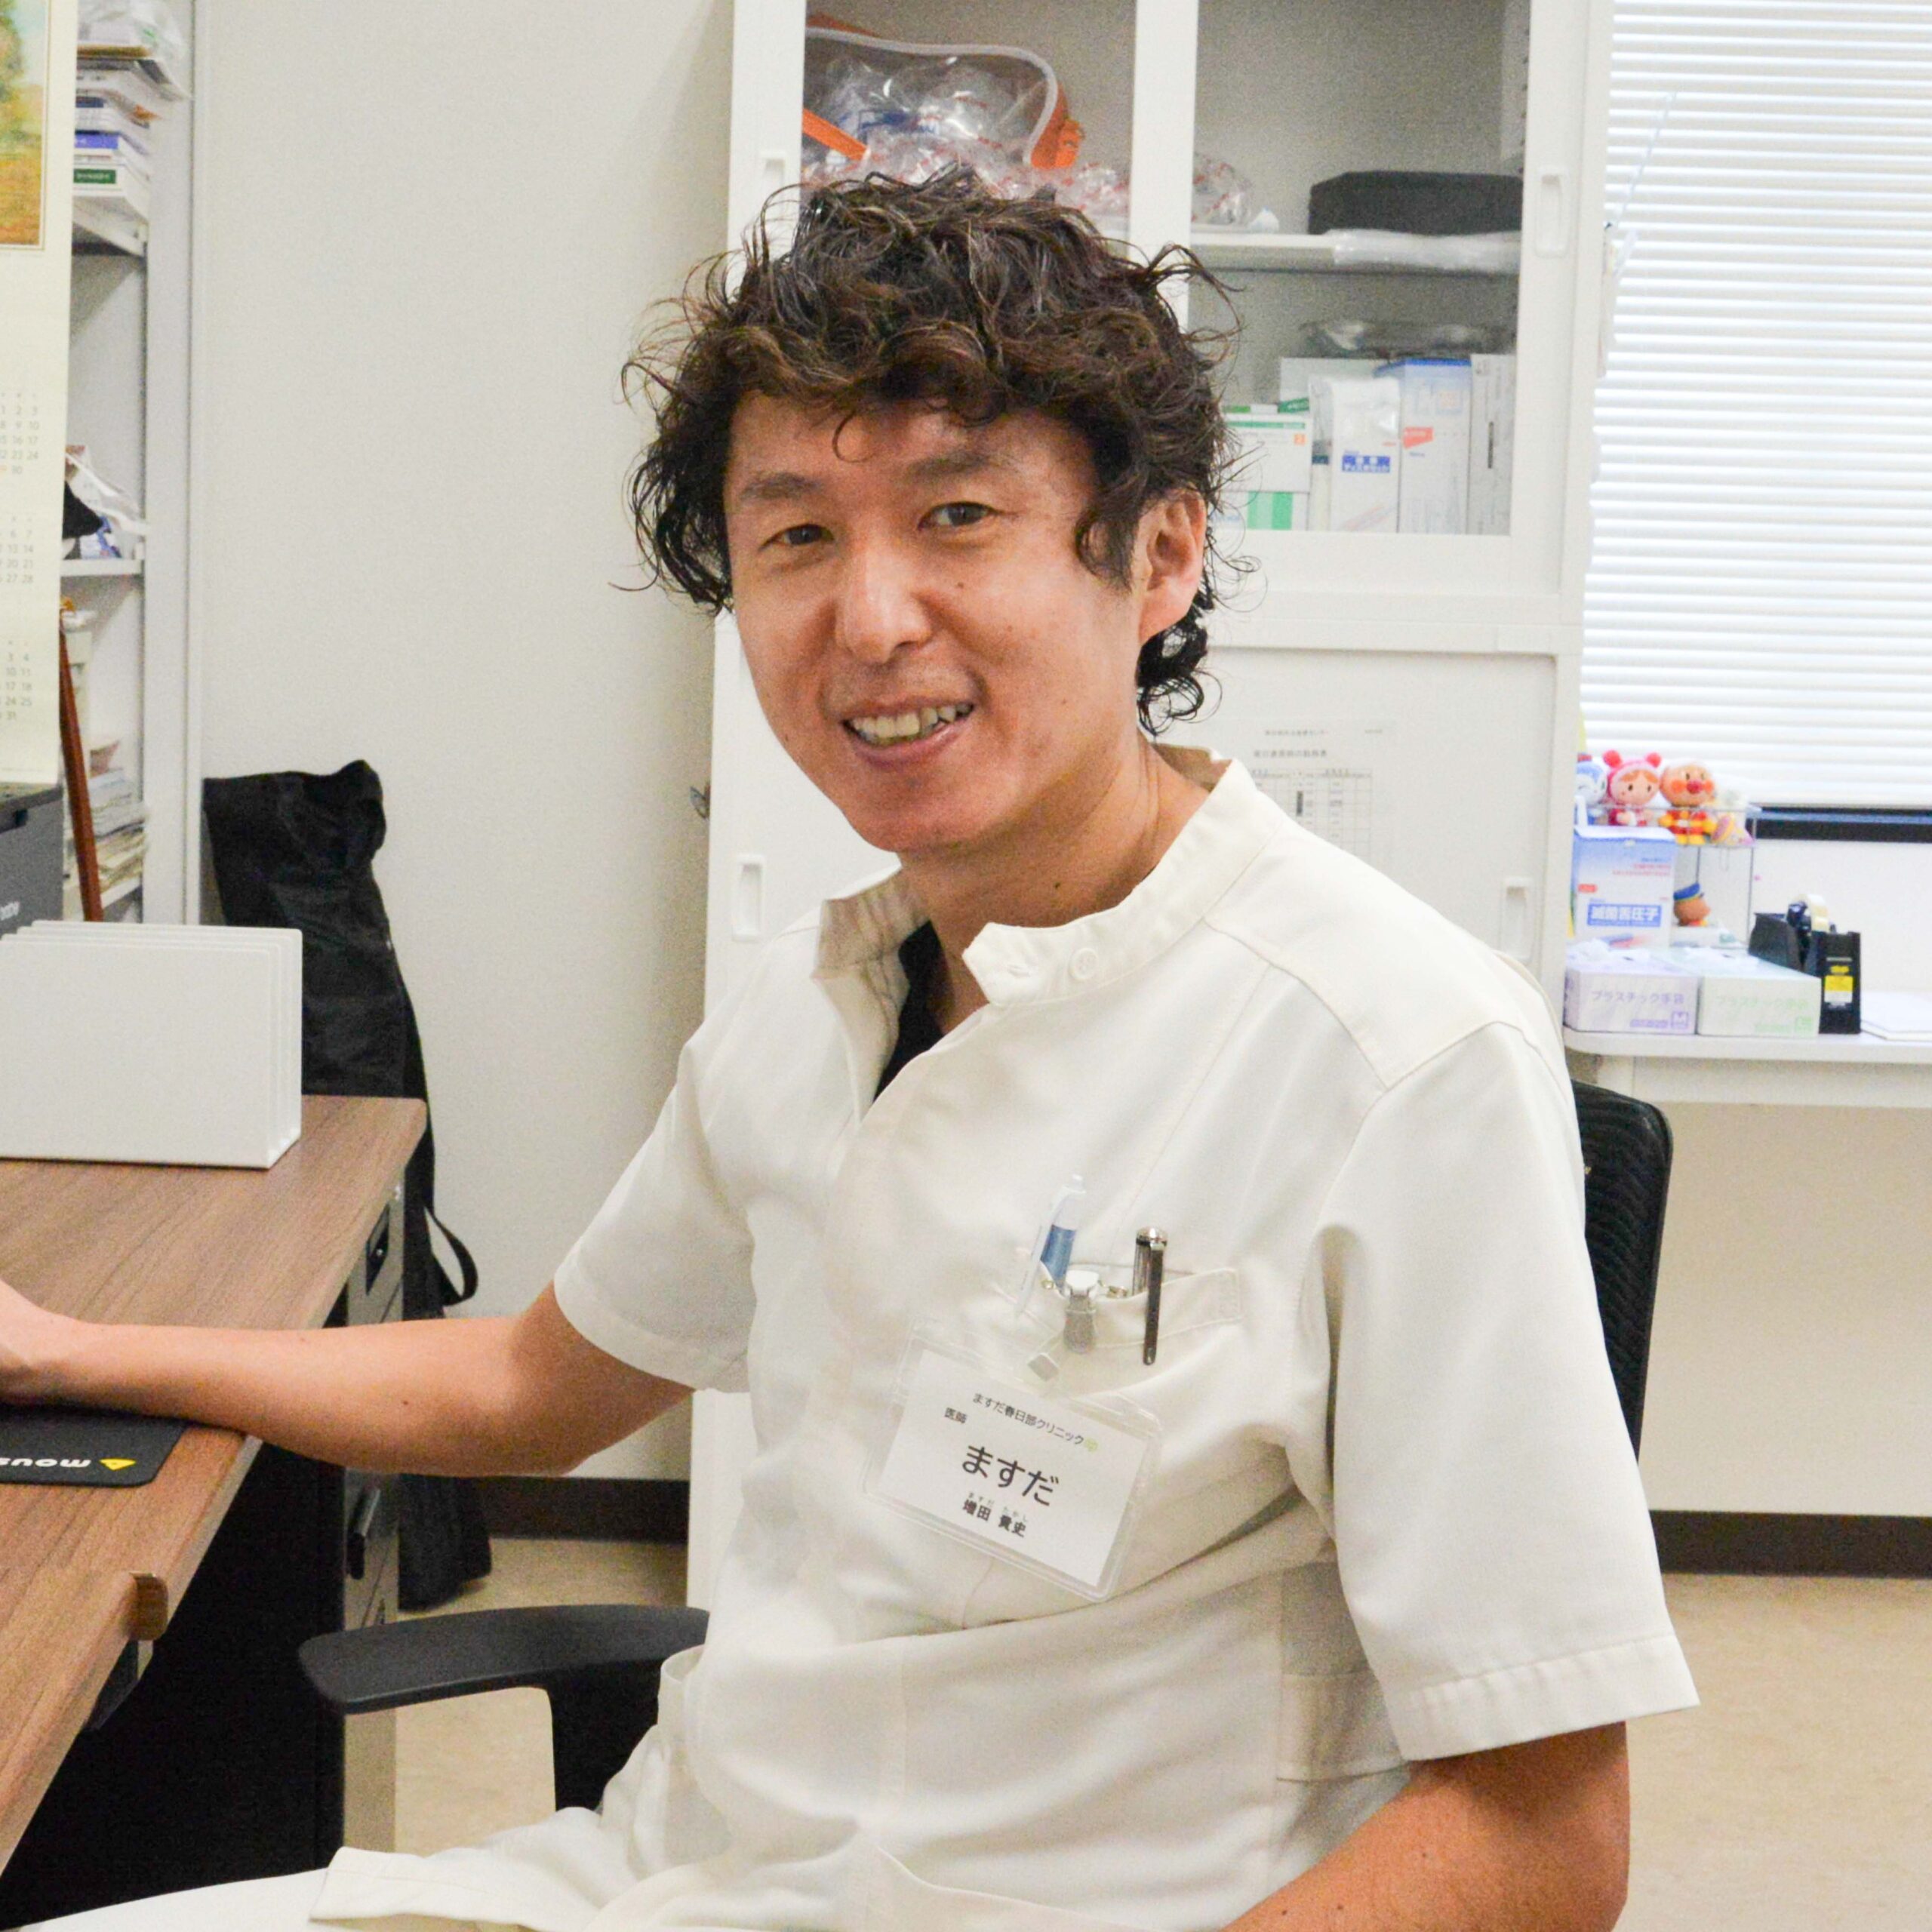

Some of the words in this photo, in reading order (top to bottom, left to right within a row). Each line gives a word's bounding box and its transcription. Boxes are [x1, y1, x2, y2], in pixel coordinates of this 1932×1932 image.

[29, 420, 40, 430] 10
[12, 435, 23, 445] 16
[27, 435, 38, 445] 17
[11, 449, 23, 460] 23
[26, 451, 38, 460] 24
[23, 544, 34, 553] 14
[7, 558, 19, 568] 20
[23, 558, 33, 569] 21
[6, 573, 18, 583] 27
[22, 574, 34, 584] 28
[6, 681, 16, 691] 17
[5, 696, 17, 706] 24
[20, 697, 32, 707] 25
[944, 1407, 968, 1424] 医師
[973, 1393, 1084, 1445] ますだ春日部クリニック
[962, 1446, 1059, 1506] ますだ
[962, 1499, 992, 1521] 増田
